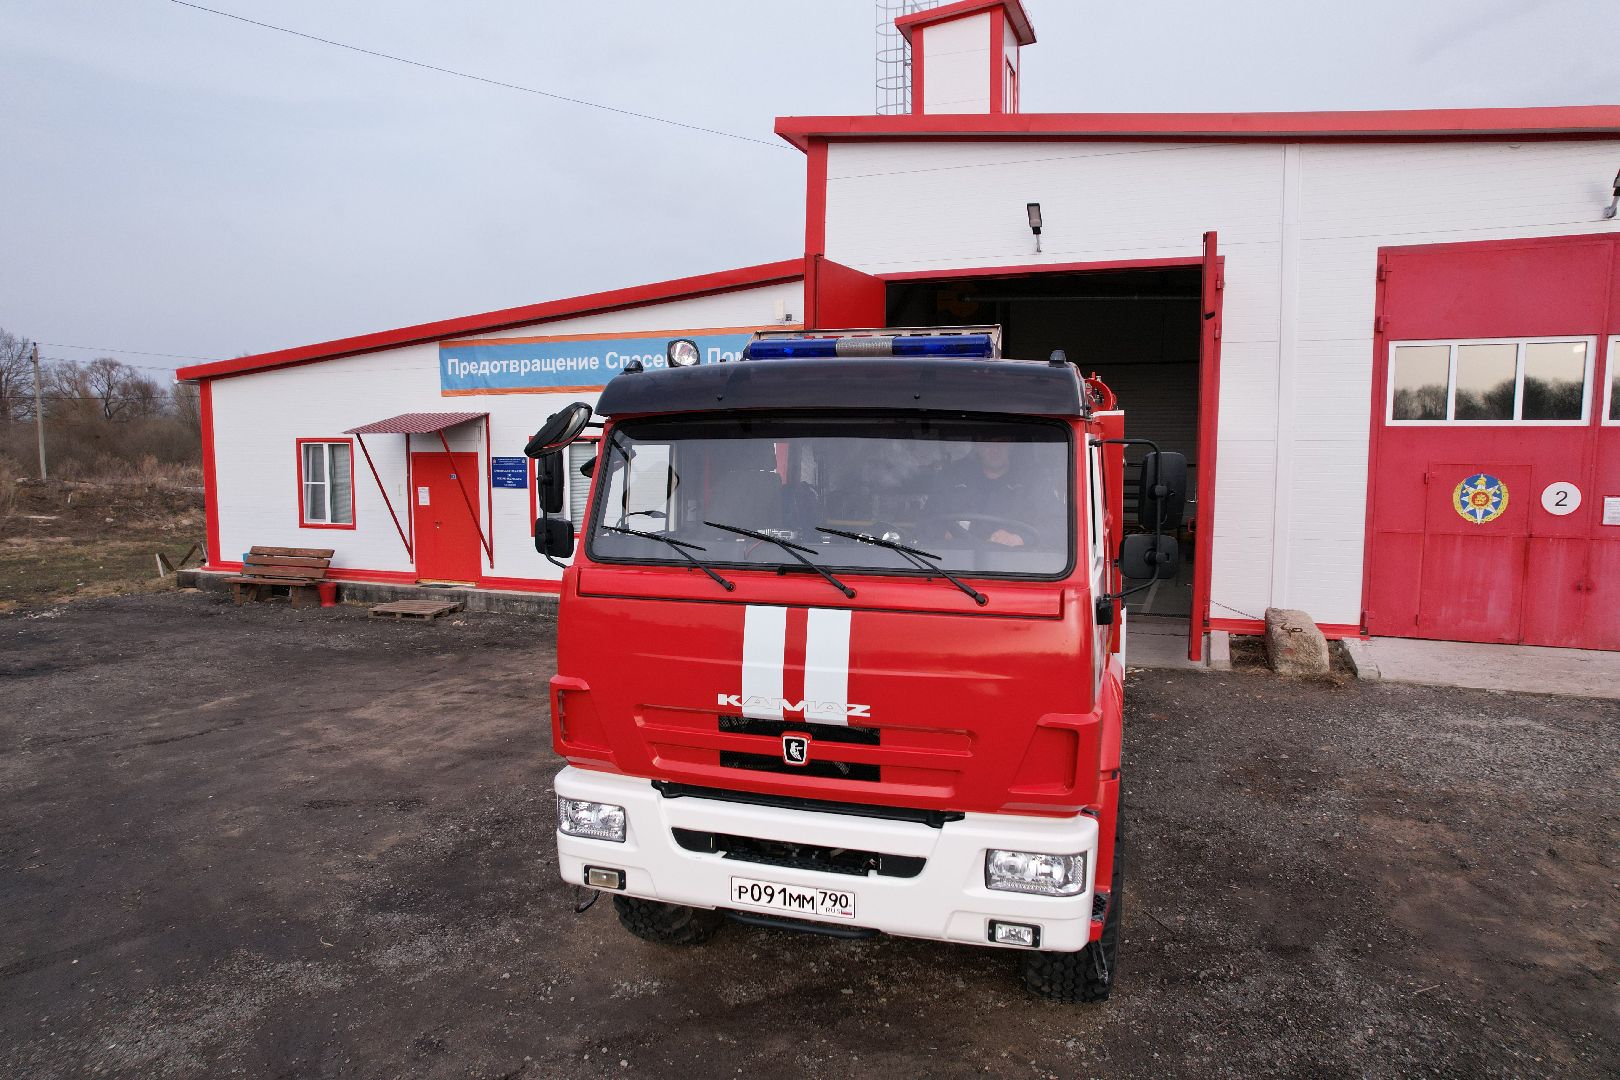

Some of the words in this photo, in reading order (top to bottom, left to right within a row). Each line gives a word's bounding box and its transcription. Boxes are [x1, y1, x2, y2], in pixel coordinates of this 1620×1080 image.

[447, 355, 600, 379] Предотвращение
[1554, 490, 1568, 507] 2
[717, 693, 871, 718] KAMAZ
[818, 891, 849, 909] 790
